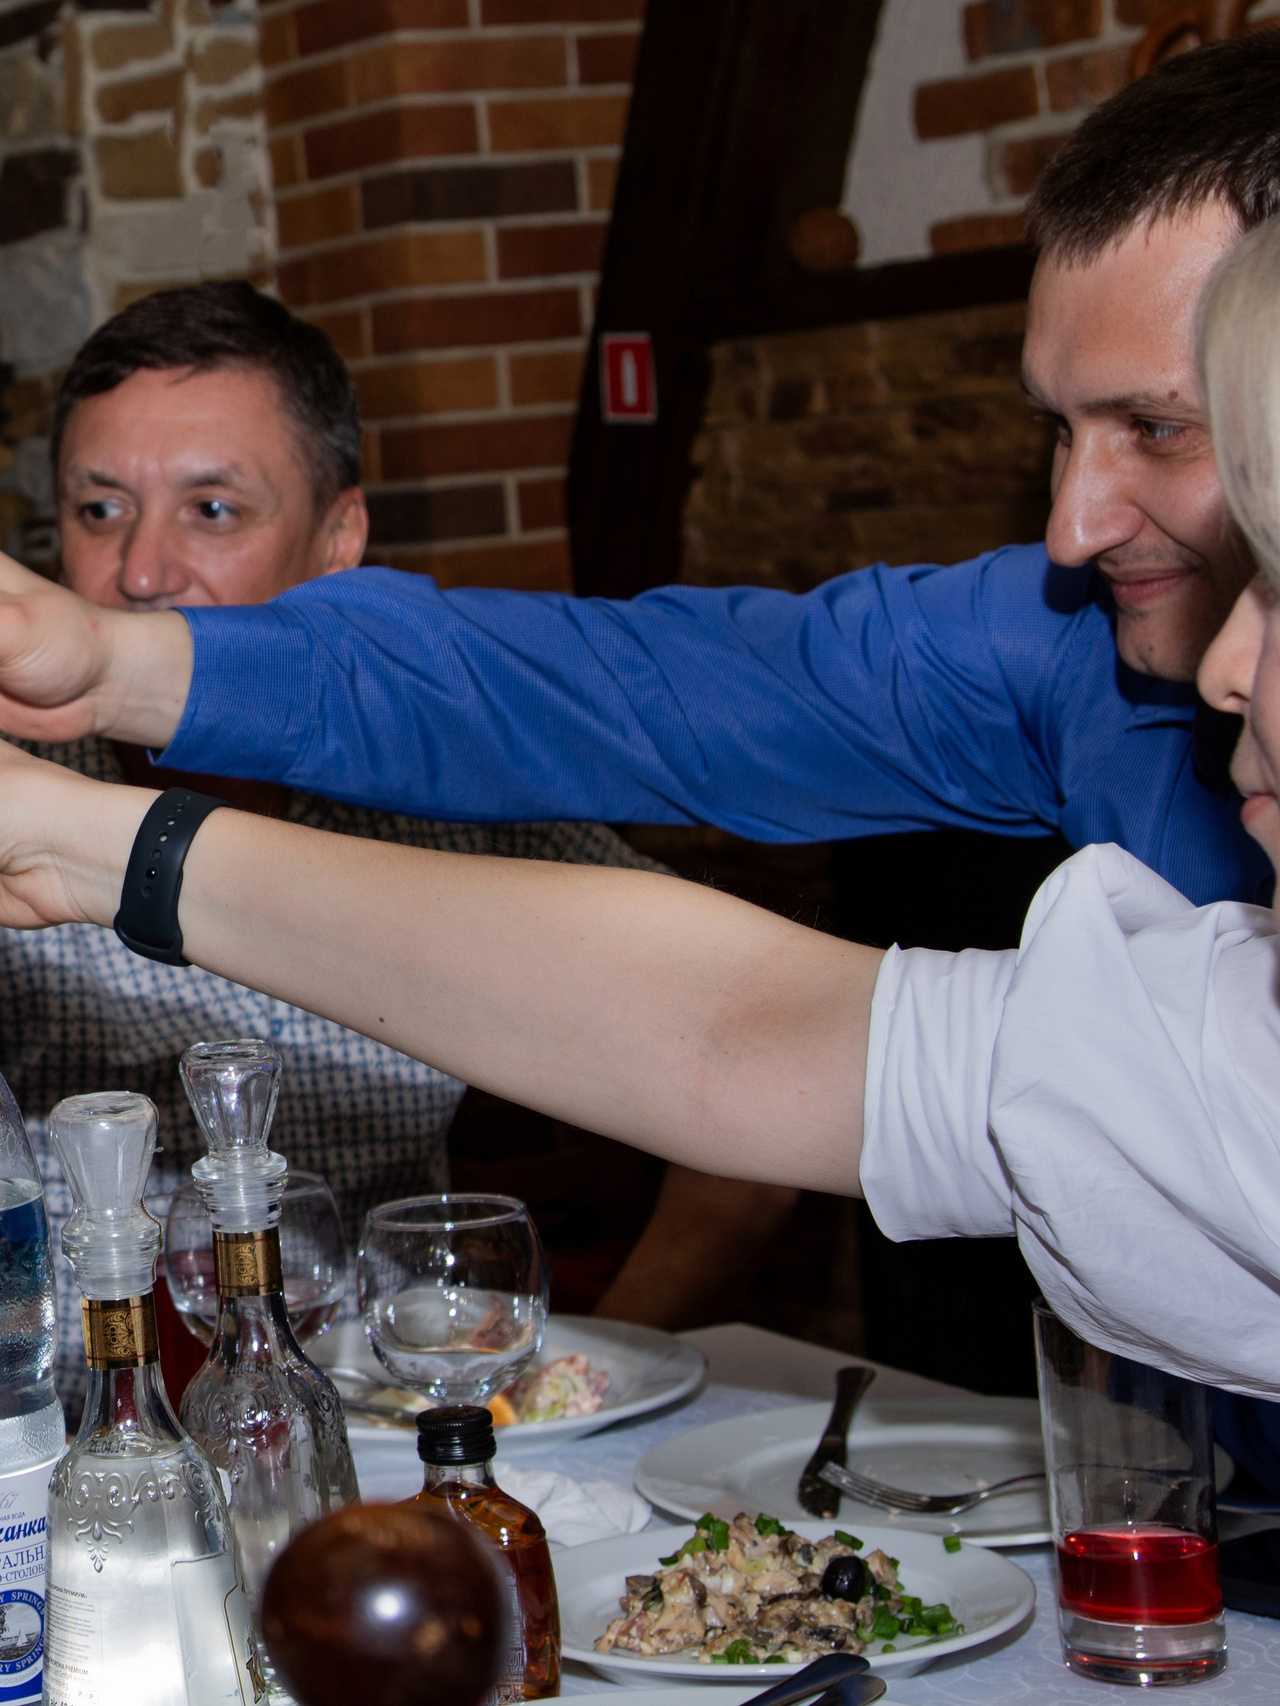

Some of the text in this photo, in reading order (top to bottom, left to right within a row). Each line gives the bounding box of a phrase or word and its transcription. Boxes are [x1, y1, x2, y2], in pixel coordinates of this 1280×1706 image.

[88, 1439, 127, 1453] 21.04.14
[12, 1511, 26, 1520] ВОДА
[11, 1591, 44, 1616] SPRINGS
